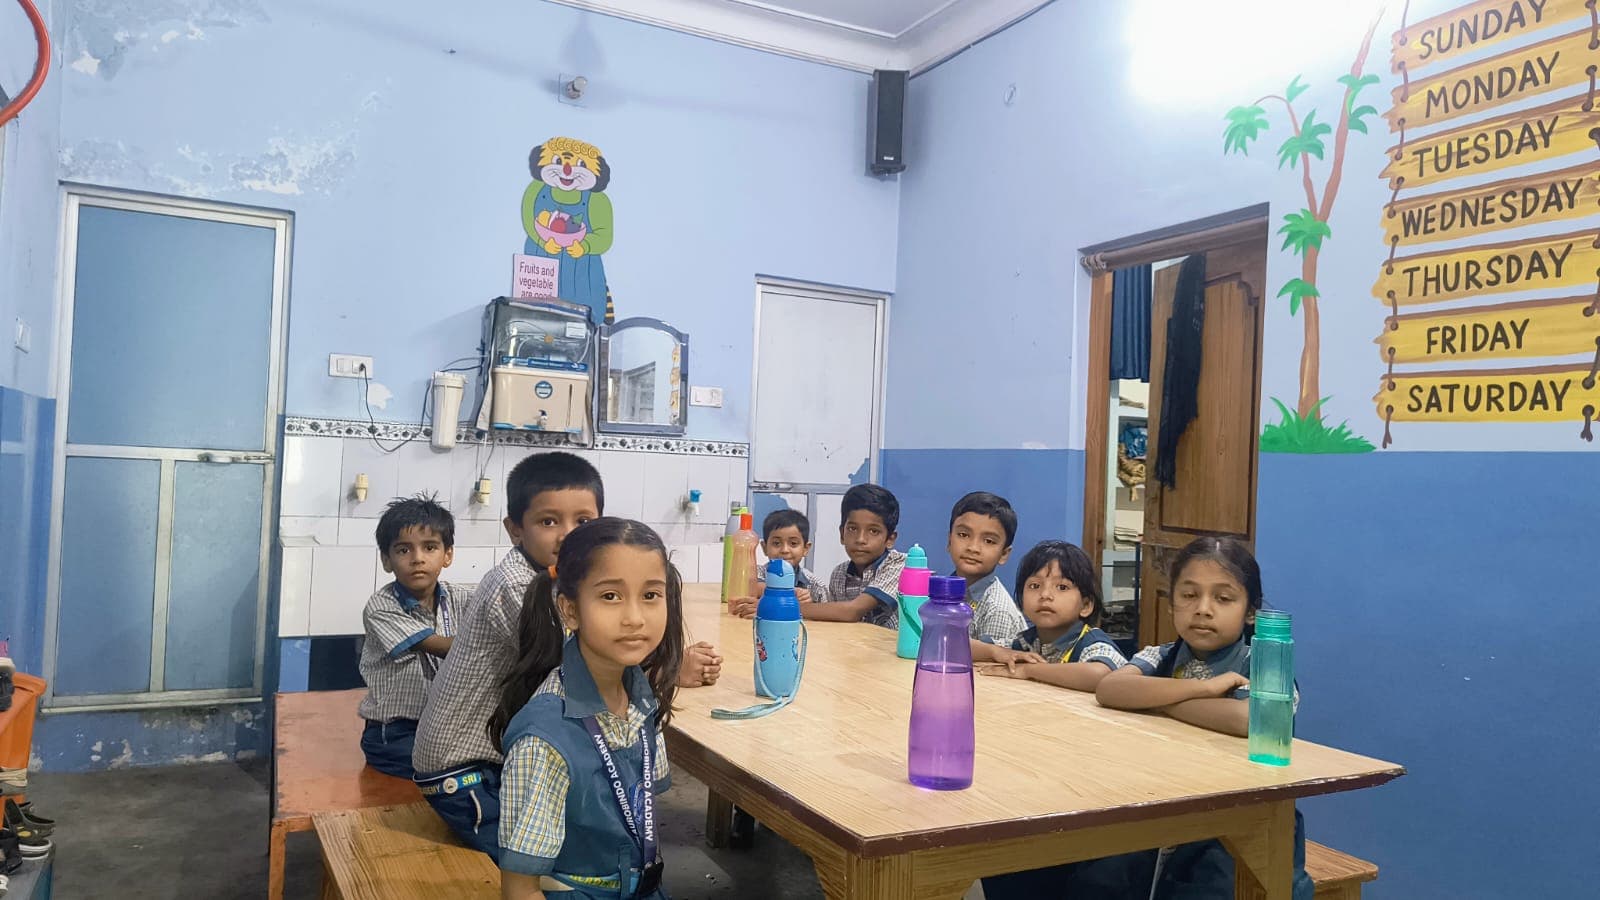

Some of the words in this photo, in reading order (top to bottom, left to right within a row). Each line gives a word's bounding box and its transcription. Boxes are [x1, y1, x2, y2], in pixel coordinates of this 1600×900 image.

[1418, 0, 1546, 60] SUNDAY
[1425, 51, 1560, 118] MONDAY
[1412, 115, 1559, 178] TUESDAY
[1402, 178, 1583, 238] WEDNESDAY
[519, 261, 540, 275] Fruits
[541, 265, 555, 277] and
[519, 277, 553, 289] vegetable
[1402, 243, 1573, 297] THURSDAY
[1426, 318, 1530, 355] FRIDAY
[1407, 379, 1572, 413] SATURDAY
[462, 773, 477, 785] SRI
[594, 734, 619, 779] ACADEMY
[613, 781, 639, 835] AUROBINDO
[644, 790, 654, 842] ACADEMY
